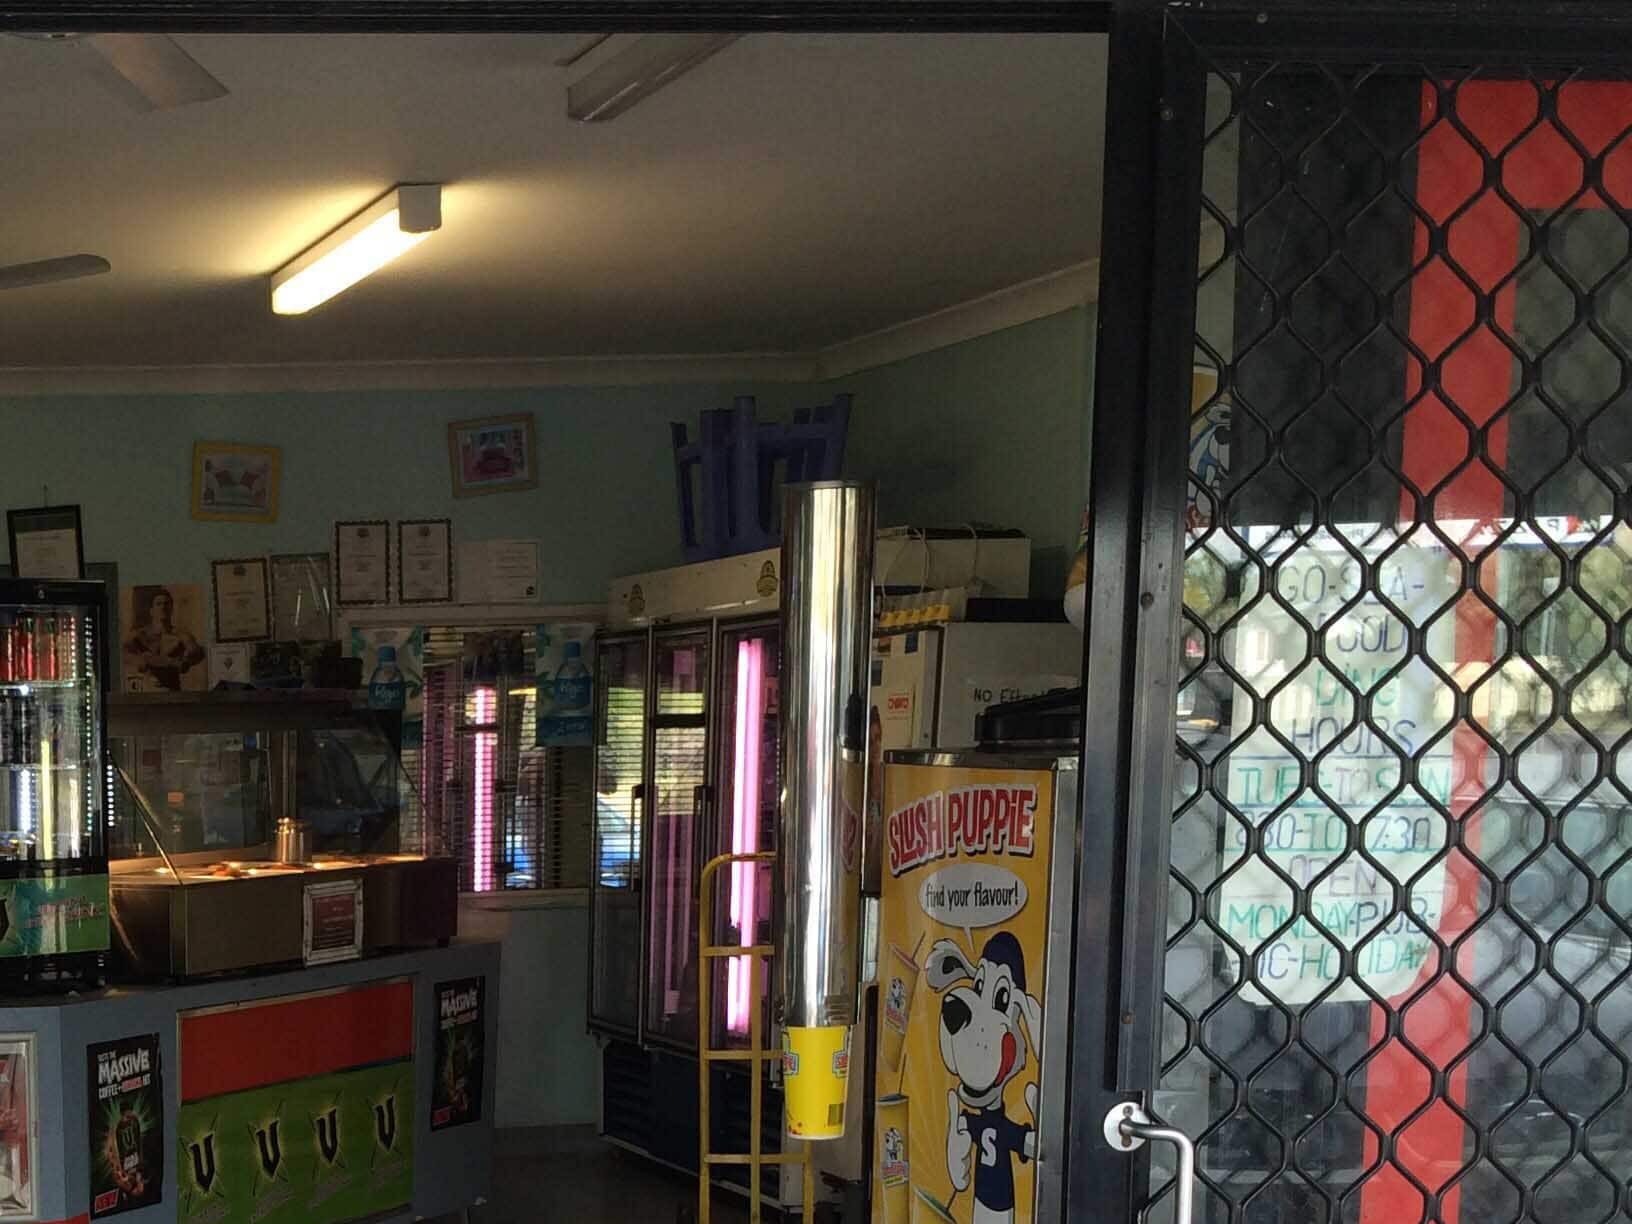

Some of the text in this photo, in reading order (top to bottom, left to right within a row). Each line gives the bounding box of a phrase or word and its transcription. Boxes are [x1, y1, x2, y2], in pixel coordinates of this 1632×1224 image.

[1292, 716, 1416, 755] HOURS
[889, 793, 944, 871] SLUSH
[926, 881, 1019, 912] find your flavour!
[98, 1048, 150, 1085] MASSIVE
